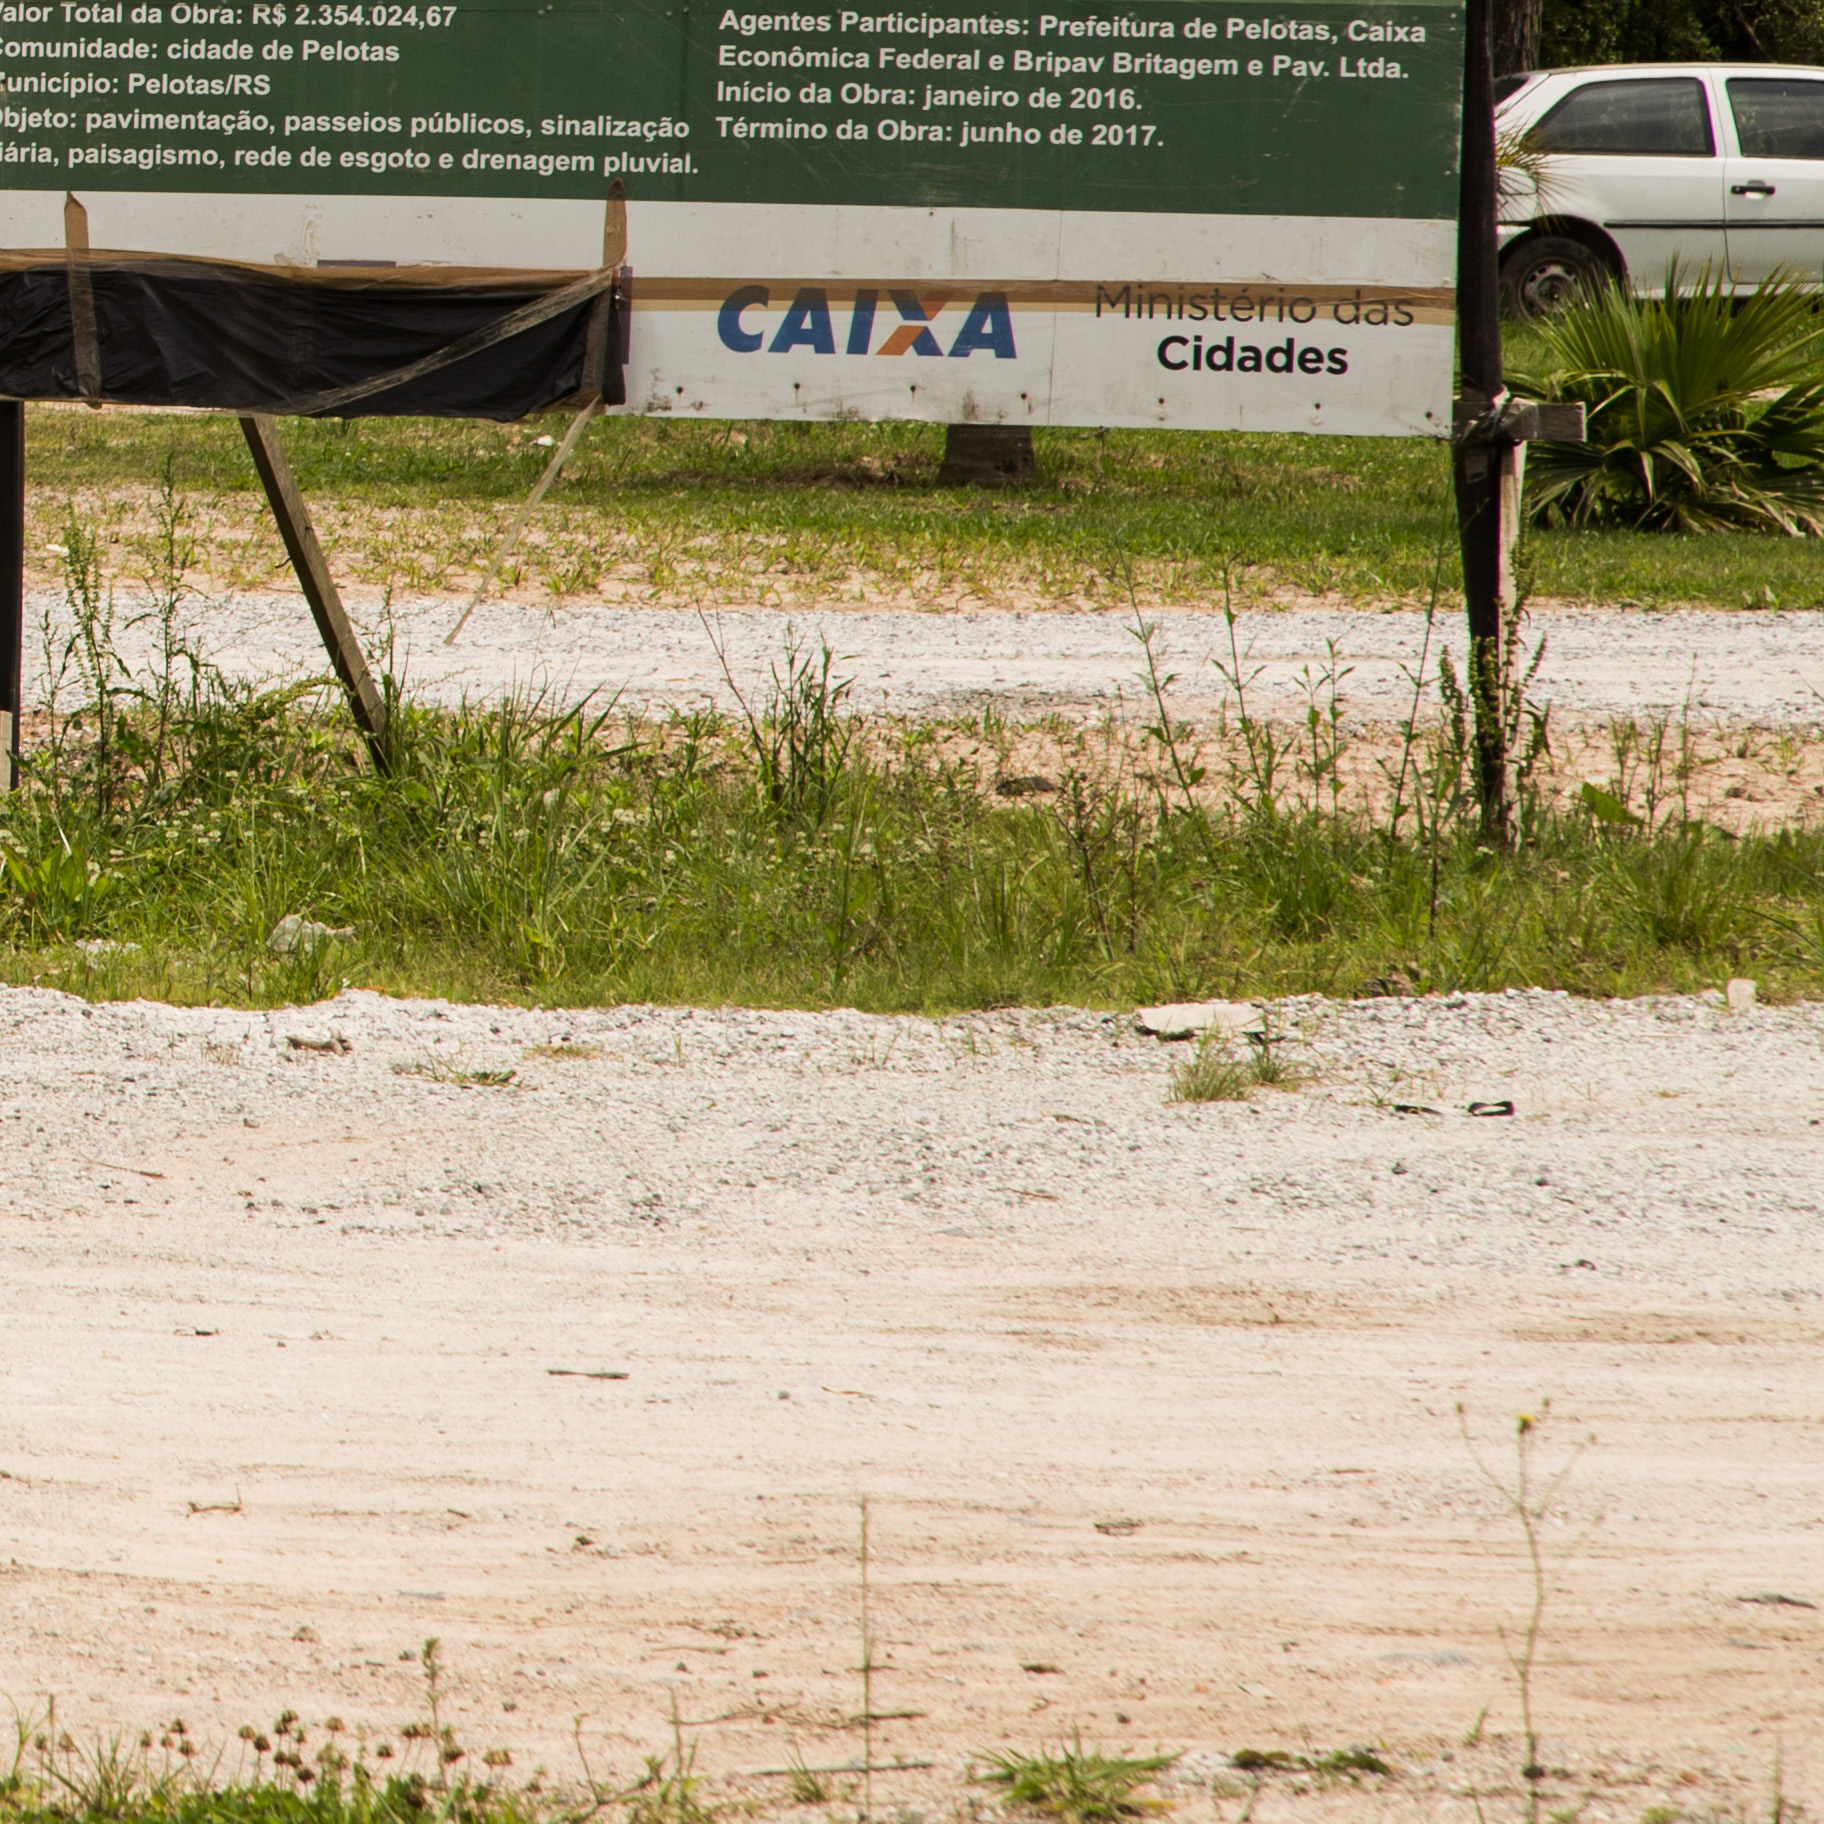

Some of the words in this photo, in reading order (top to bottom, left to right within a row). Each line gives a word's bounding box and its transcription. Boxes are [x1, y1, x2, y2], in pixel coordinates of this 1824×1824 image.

[59, 0, 123, 25] Total
[130, 1, 162, 24] da
[170, 2, 243, 26] Obra:
[252, 2, 287, 28] R$
[294, 3, 457, 30] 2.354.024,67
[718, 9, 831, 37] Agentes
[840, 11, 1029, 39] Participantes:
[1039, 13, 1175, 39] Prefeitura
[1183, 17, 1217, 40] de
[1226, 16, 1338, 46] Pelotas,
[1347, 18, 1426, 43] Caixa
[166, 37, 254, 61] cidade
[261, 39, 294, 62] de
[302, 38, 400, 63] Pelotas
[718, 44, 869, 70] Econômica
[878, 46, 980, 71] Federal
[988, 54, 1005, 72] e
[1013, 49, 1105, 78] Bripav
[1112, 50, 1238, 80] Britagem
[1246, 58, 1263, 76] e
[1272, 54, 1330, 78] Pav.
[1339, 55, 1409, 80] Ltda.
[128, 72, 271, 96] Pelotas/RS
[717, 80, 791, 104] Início
[798, 82, 831, 105] da
[840, 81, 915, 106] Obra:
[924, 83, 1019, 112] janeiro
[1027, 85, 1062, 109] de
[1069, 86, 1142, 111] 2016.
[85, 107, 275, 137] pavimentação,
[284, 110, 402, 136] passeios
[410, 110, 532, 139] públicos,
[540, 114, 689, 144] sinalização
[715, 115, 828, 140] Término
[835, 118, 868, 141] da
[877, 118, 952, 143] Obra:
[959, 120, 1041, 149] junho
[1048, 123, 1083, 146] de
[1091, 122, 1164, 147] 2017.
[68, 141, 225, 171] paisagismo,
[234, 145, 292, 168] rede
[299, 144, 332, 168] de
[339, 147, 431, 174] esgoto
[438, 152, 454, 170] e
[461, 147, 595, 176] drenagem
[603, 150, 698, 177] pluvial.
[717, 285, 1017, 359] CAIXA
[1095, 284, 1316, 325] Ministério
[1333, 289, 1415, 328] das
[1157, 335, 1349, 376] Cidades
